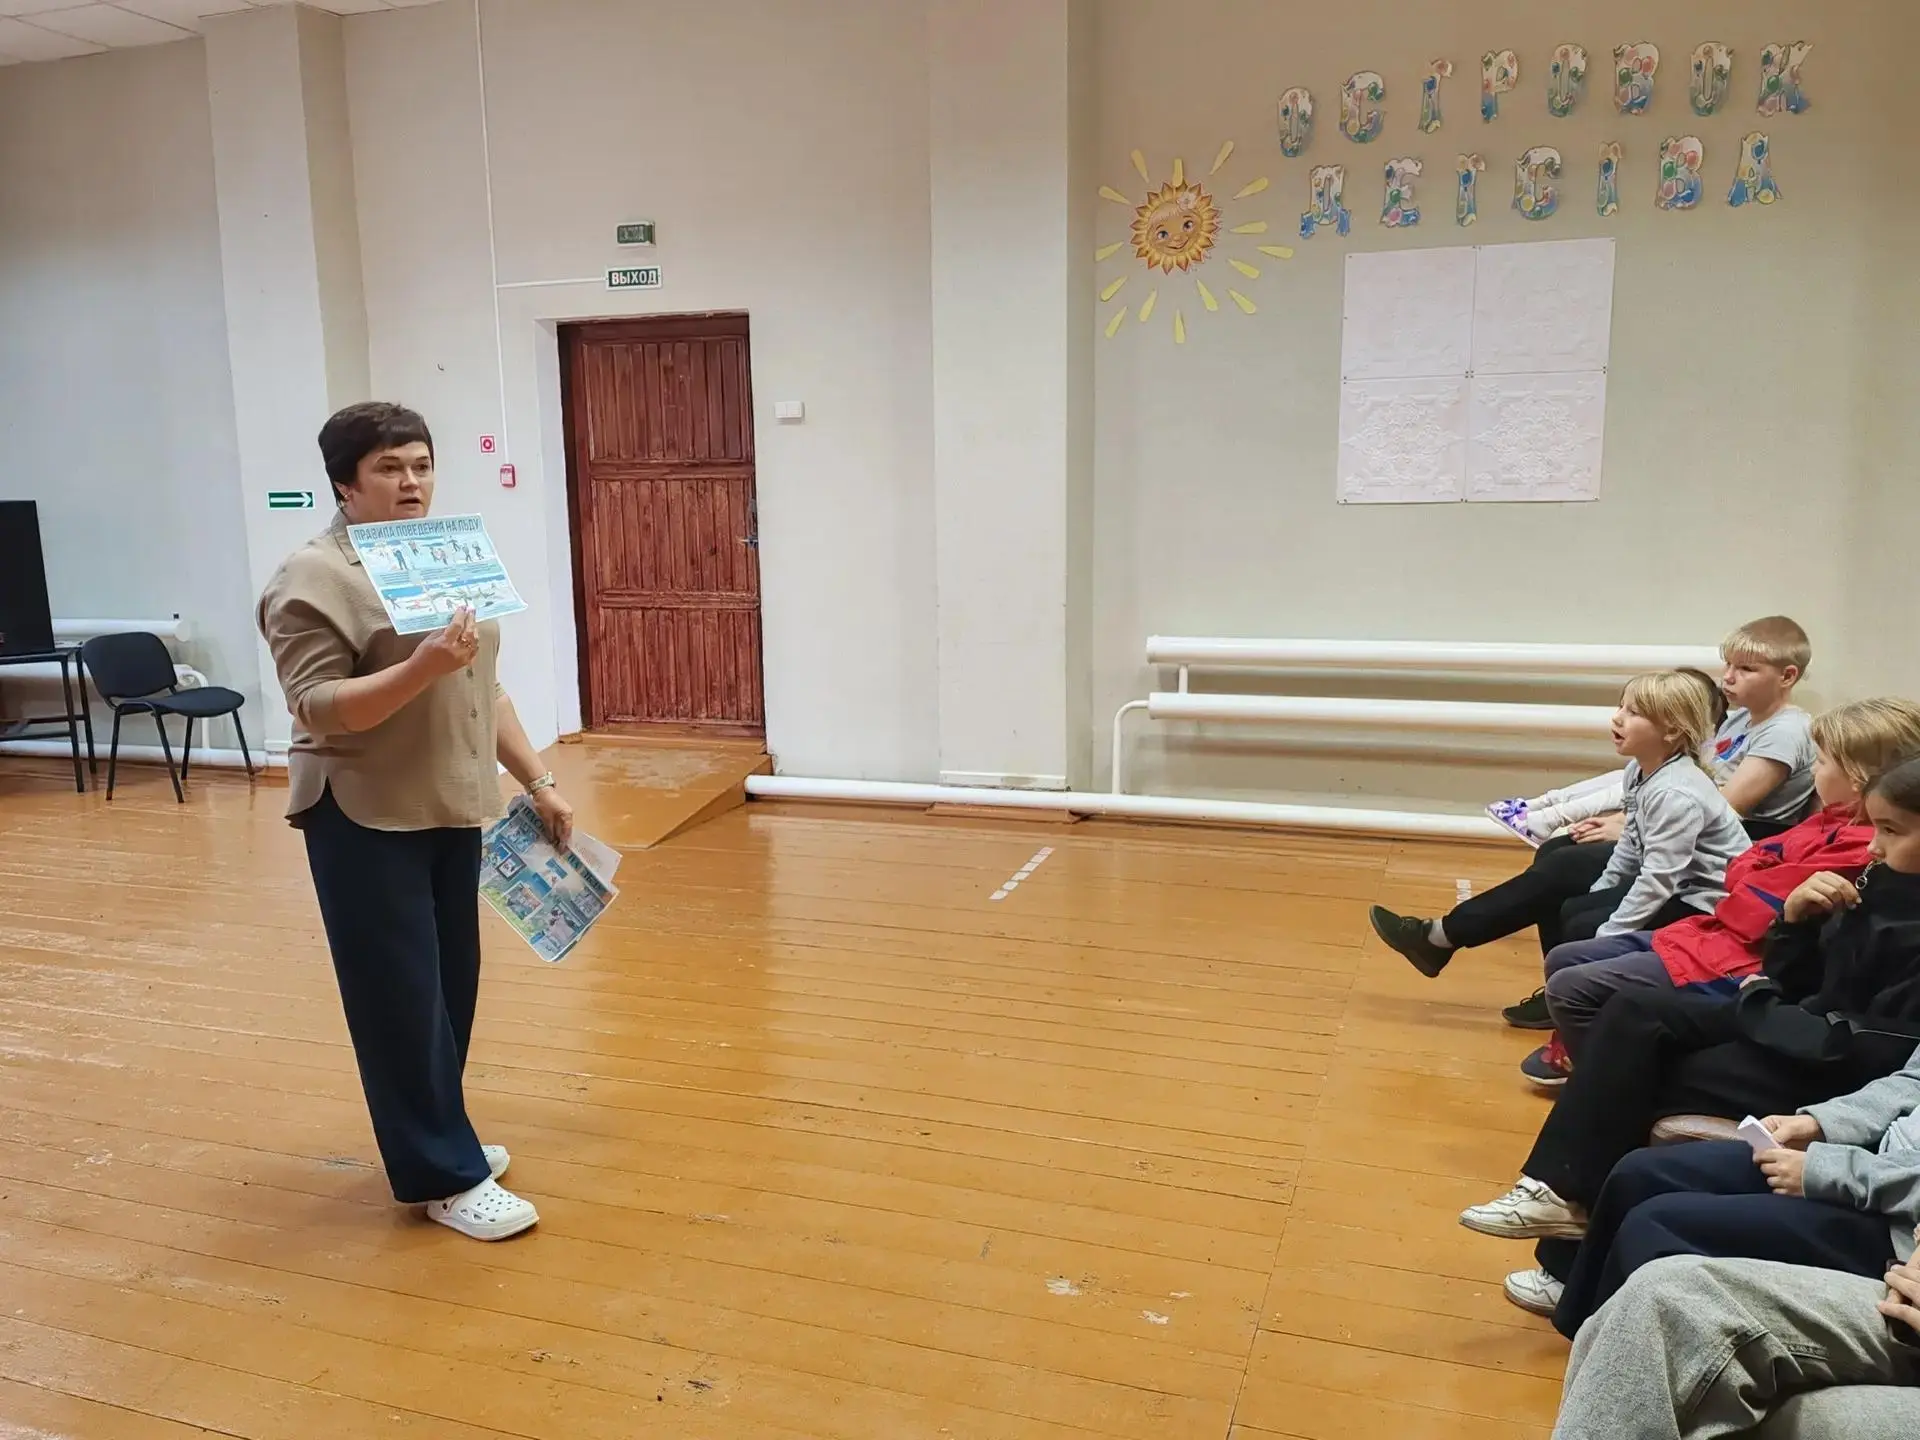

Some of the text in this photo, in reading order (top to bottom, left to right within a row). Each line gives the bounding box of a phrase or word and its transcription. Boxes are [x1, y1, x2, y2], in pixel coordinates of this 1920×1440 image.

[611, 270, 657, 285] ВЫХОД
[353, 518, 479, 541] ПРАВИЛА ПОВЕДЕНИЯ НА ЛЬДУ
